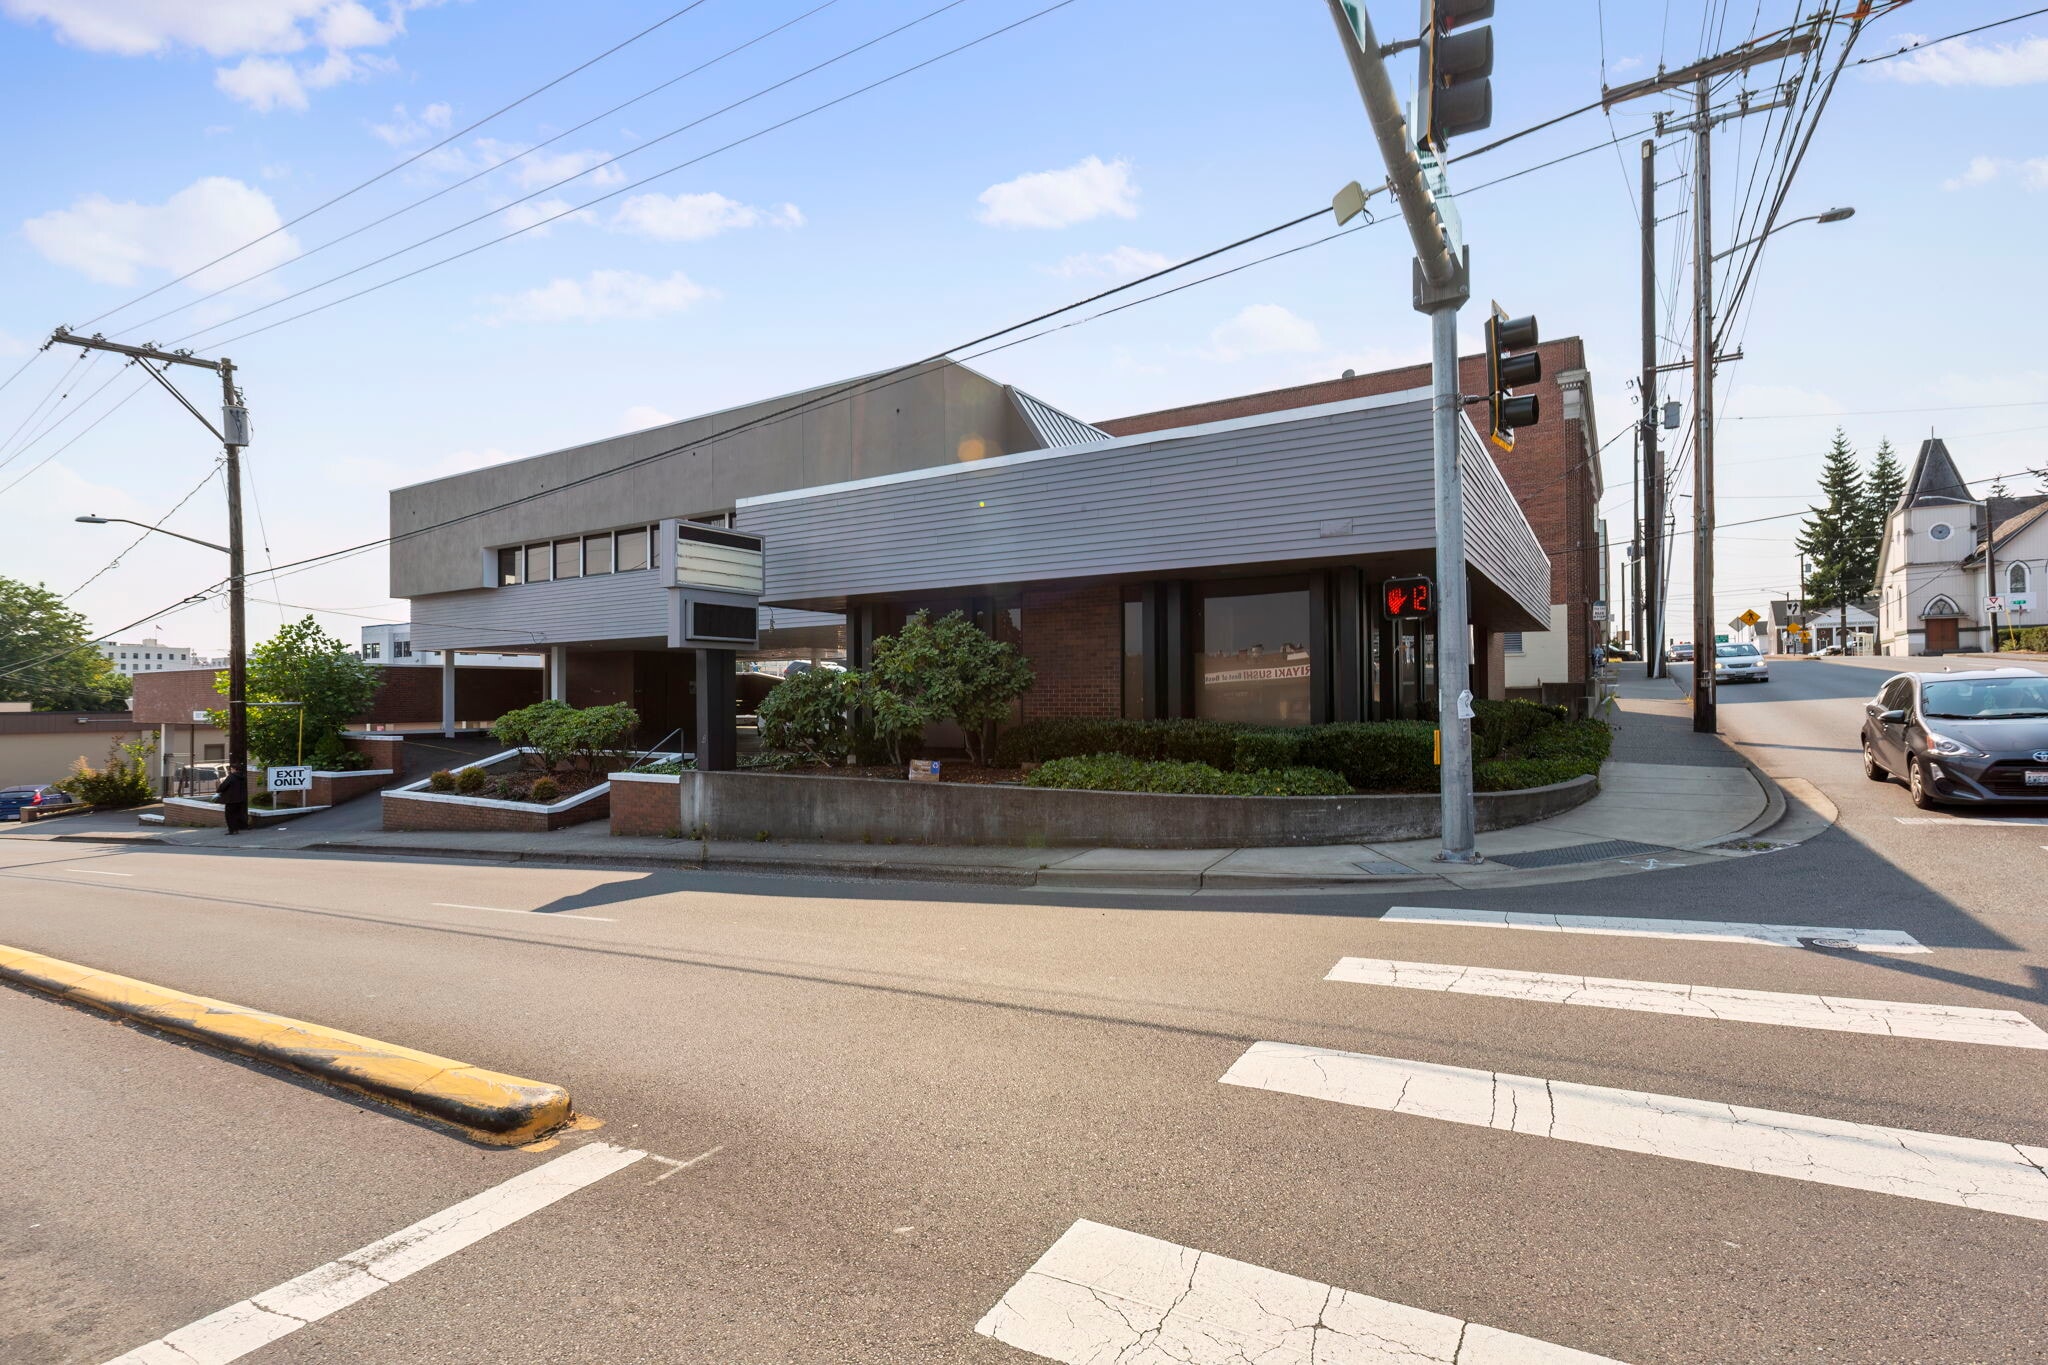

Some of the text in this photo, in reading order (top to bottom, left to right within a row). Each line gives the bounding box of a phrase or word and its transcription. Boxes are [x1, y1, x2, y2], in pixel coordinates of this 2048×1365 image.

[1413, 585, 1427, 610] 12
[276, 770, 304, 778] EXIT
[274, 778, 306, 787] ONLY
